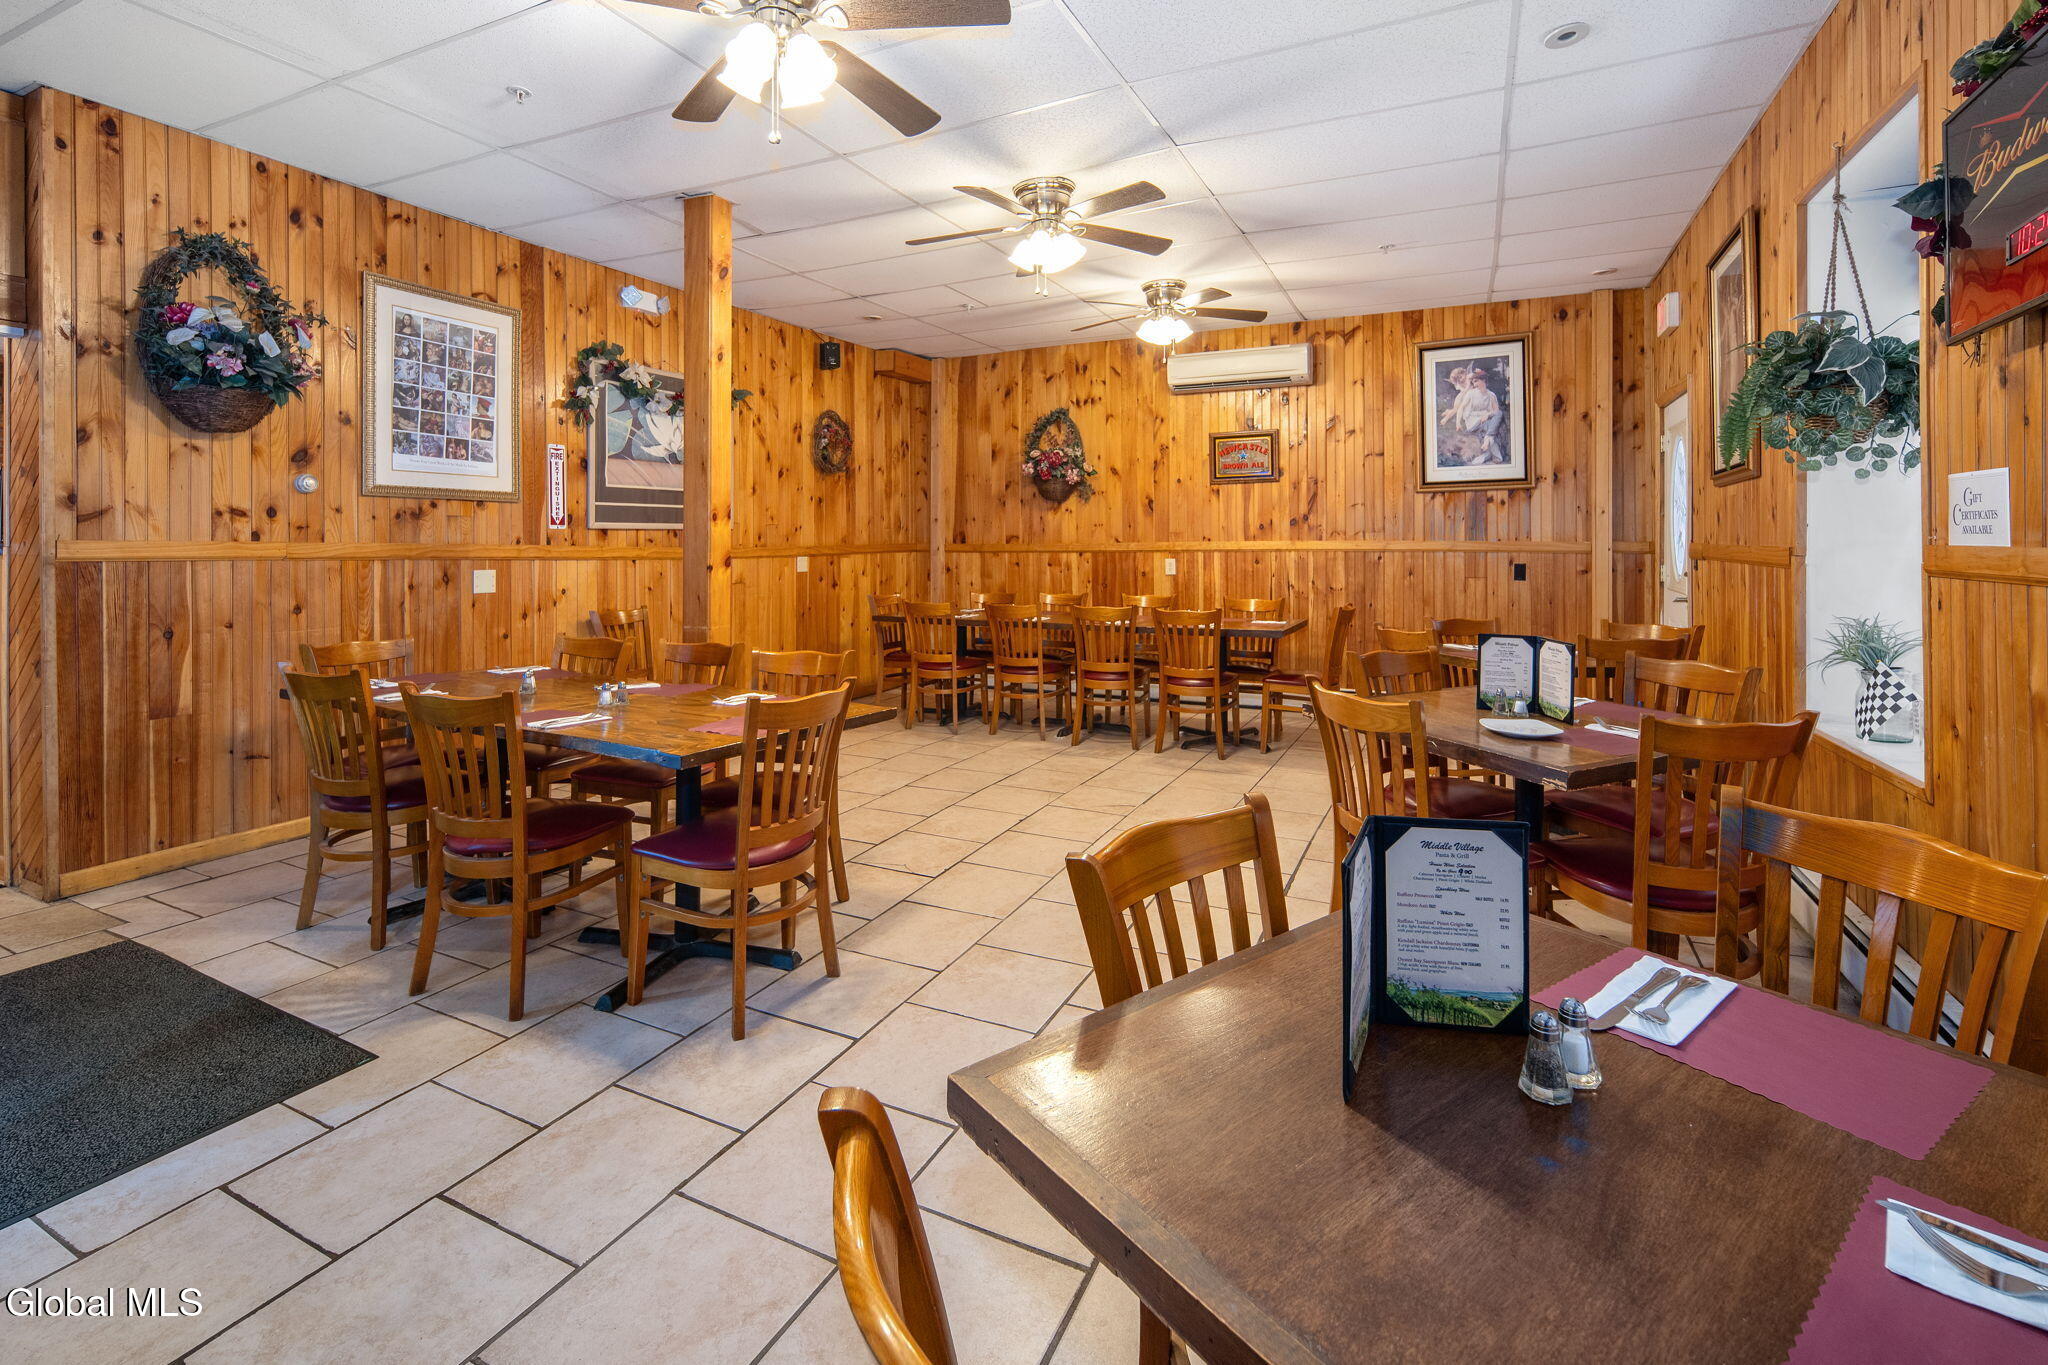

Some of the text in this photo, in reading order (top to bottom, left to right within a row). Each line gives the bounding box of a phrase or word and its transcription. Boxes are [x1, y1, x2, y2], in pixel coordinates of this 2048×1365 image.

[1967, 117, 2048, 193] Budw
[2018, 213, 2048, 255] 10:2
[1218, 443, 1269, 457] NEWCASTLE
[1963, 487, 1982, 507] GIFT
[1953, 504, 1998, 526] CERTIFICATES
[1962, 525, 1993, 534] AVAILABLE
[1420, 840, 1484, 854] Middle Village
